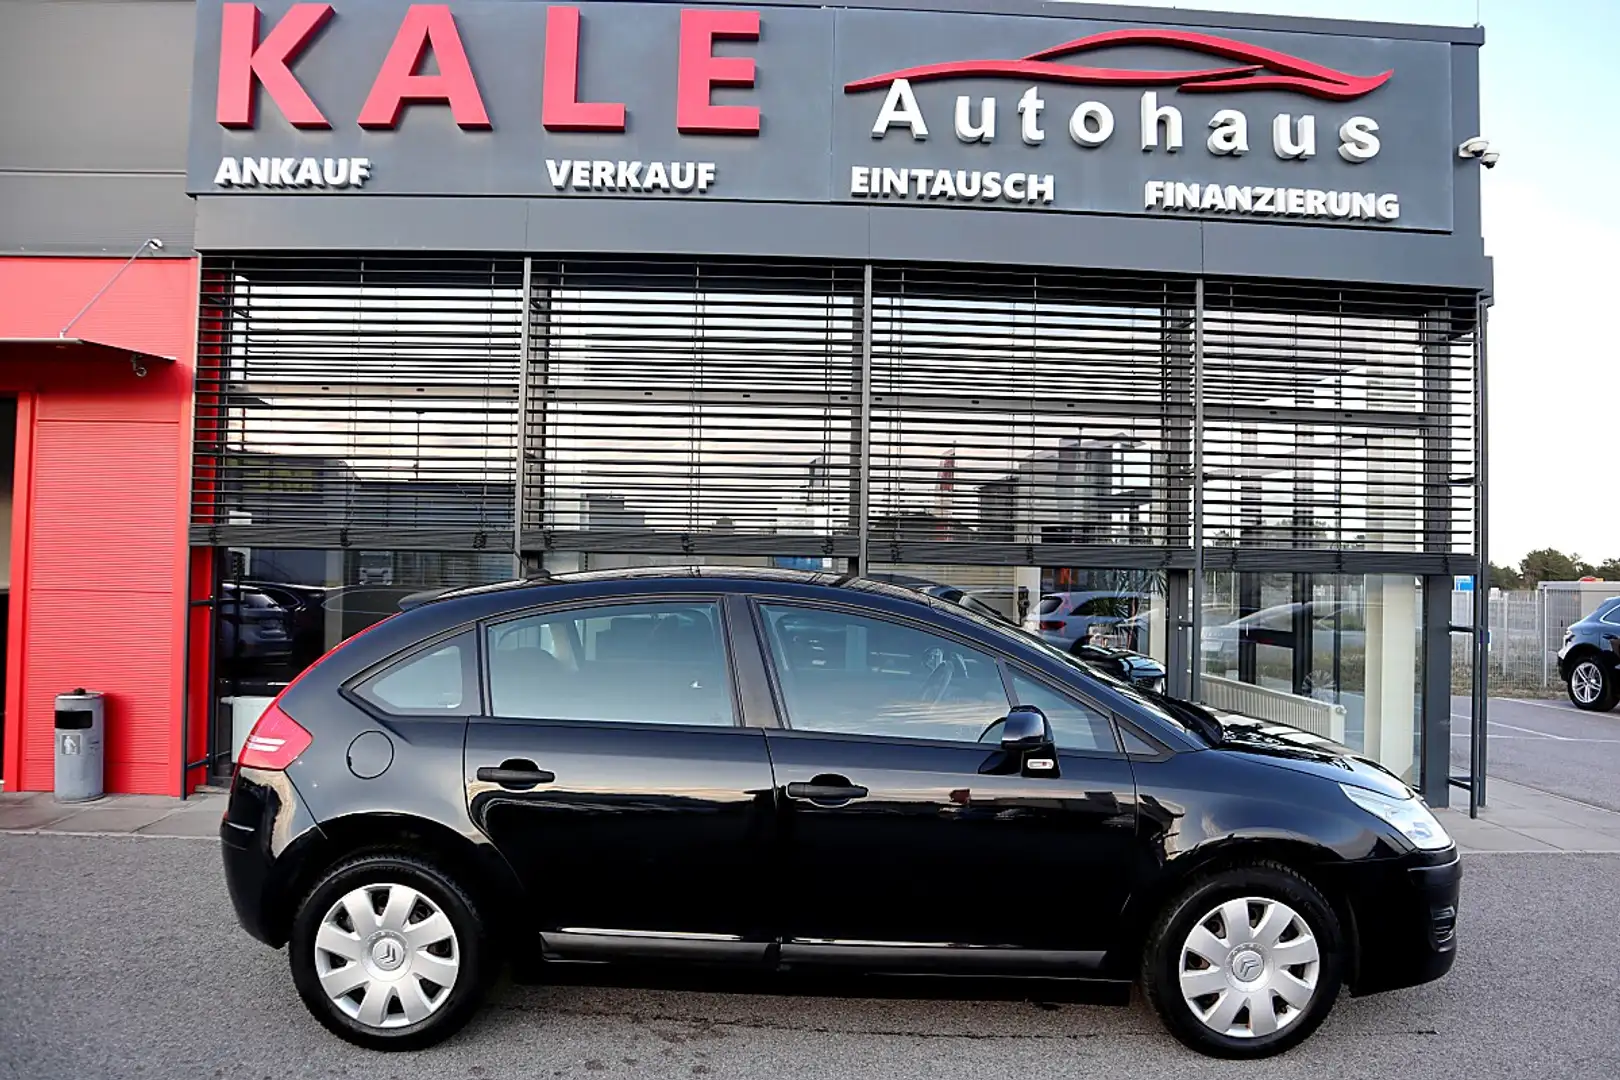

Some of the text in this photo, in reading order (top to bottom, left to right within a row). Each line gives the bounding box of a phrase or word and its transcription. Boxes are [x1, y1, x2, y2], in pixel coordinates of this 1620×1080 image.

[217, 3, 762, 136] KALE
[871, 78, 1382, 163] Autohaus
[213, 156, 371, 190] ANKAUF
[545, 159, 717, 193] VERKAUF
[850, 165, 1055, 204] EINTAUSCH
[1144, 180, 1400, 220] FINANZIERUNG
